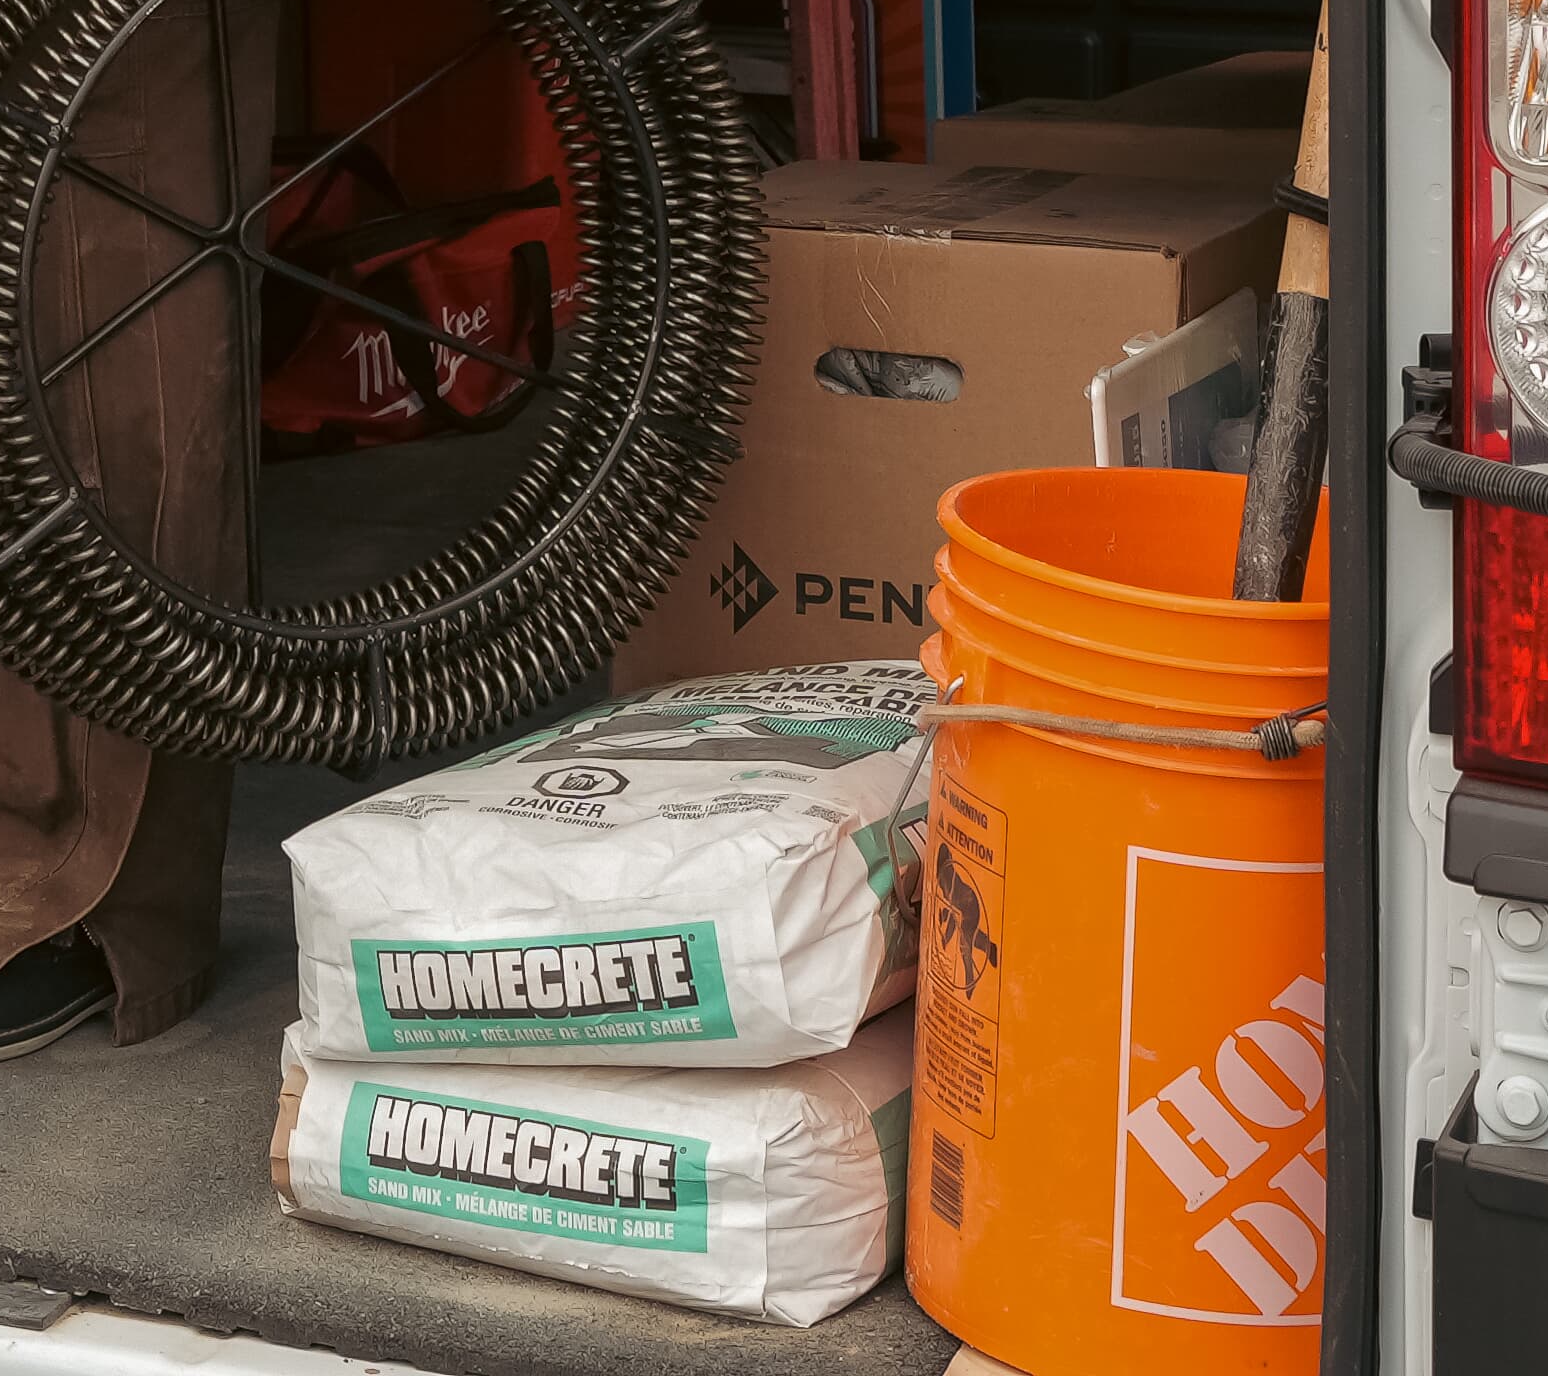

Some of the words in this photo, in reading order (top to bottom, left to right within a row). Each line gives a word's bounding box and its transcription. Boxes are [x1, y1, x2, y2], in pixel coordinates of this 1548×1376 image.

[796, 573, 934, 626] PEN
[478, 806, 547, 821] CORROSIVE
[506, 797, 607, 819] DANGER
[949, 790, 988, 830] WARNING
[947, 822, 994, 865] ATTENTION
[377, 935, 699, 1019] HOMECRETE
[393, 1028, 435, 1043] SAND
[438, 1027, 469, 1043] MIX
[481, 1024, 556, 1043] MÉLANGE
[561, 1026, 583, 1040] DE
[586, 1021, 647, 1039] CIMENT
[651, 1017, 704, 1035] SABLE
[367, 1094, 677, 1211] HOMECRETE
[367, 1177, 409, 1200] SAND
[412, 1185, 442, 1207] MIX
[455, 1190, 529, 1222] MÉLANGE
[532, 1208, 553, 1226] DE
[556, 1211, 618, 1237] CIMENT
[622, 1219, 675, 1241] SABLE
